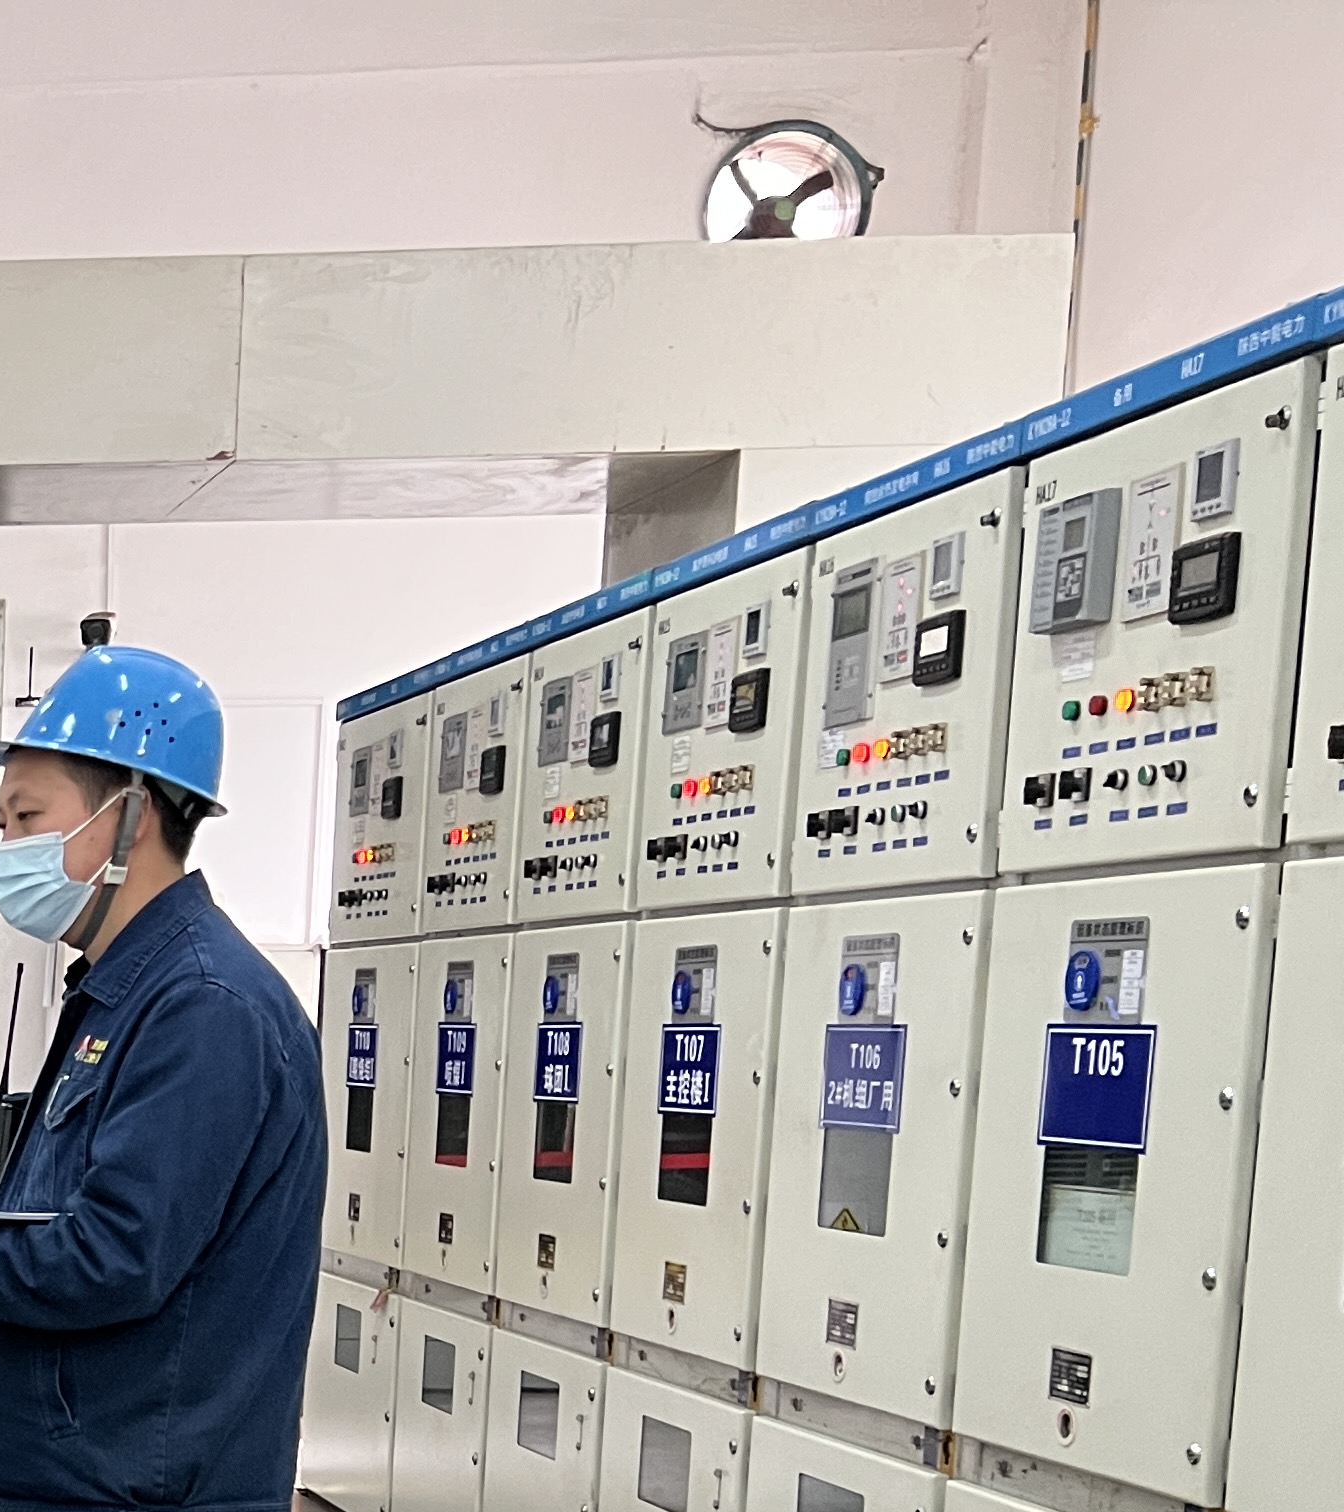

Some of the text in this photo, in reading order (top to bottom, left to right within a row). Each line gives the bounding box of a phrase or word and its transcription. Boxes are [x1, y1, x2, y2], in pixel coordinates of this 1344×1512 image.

[547, 1031, 570, 1056] T108
[675, 1034, 705, 1061] T107
[850, 1043, 881, 1069] T106
[1072, 1037, 1125, 1076] T105
[828, 1078, 894, 1111] 2#机组厂用
